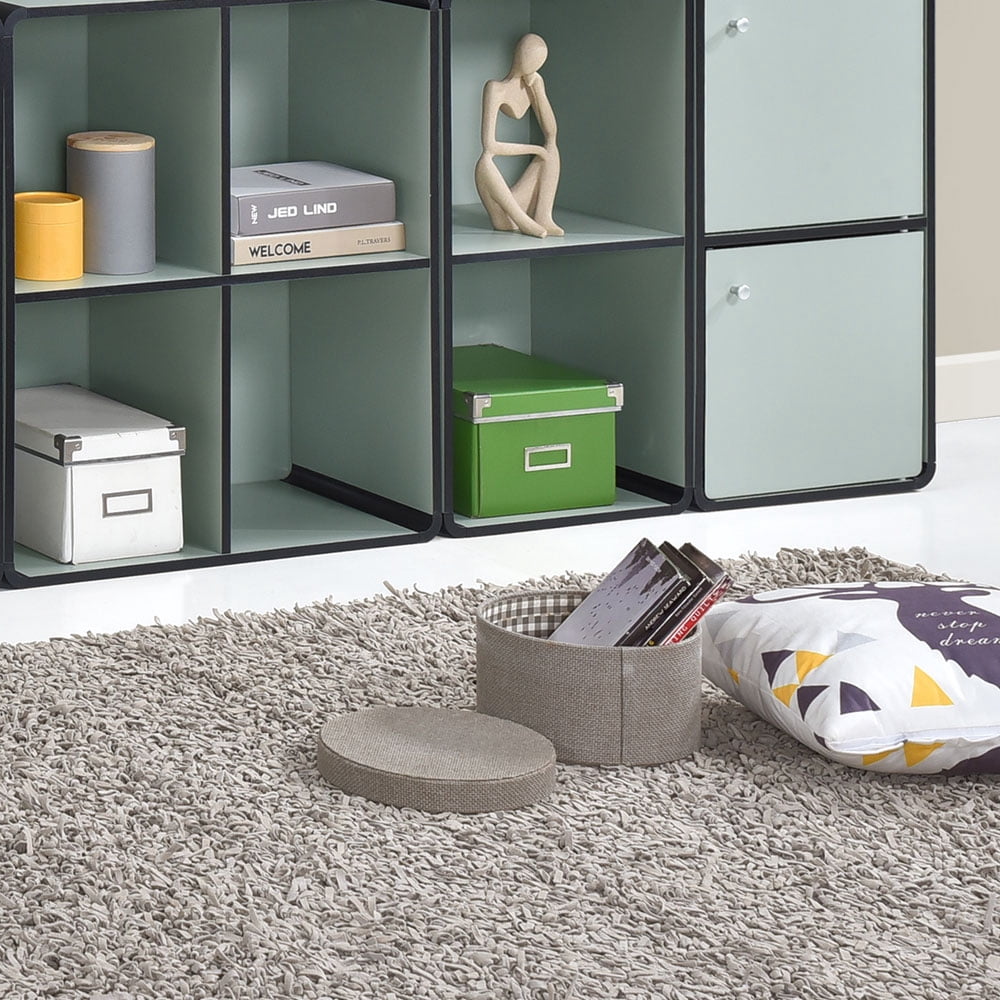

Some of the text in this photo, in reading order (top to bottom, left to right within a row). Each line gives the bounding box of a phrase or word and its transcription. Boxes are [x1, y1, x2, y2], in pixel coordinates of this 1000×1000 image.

[250, 204, 258, 225] NEW
[267, 202, 338, 219] JED LIND
[249, 241, 311, 258] WELCOME
[915, 610, 979, 618] never
[937, 620, 987, 633] stop
